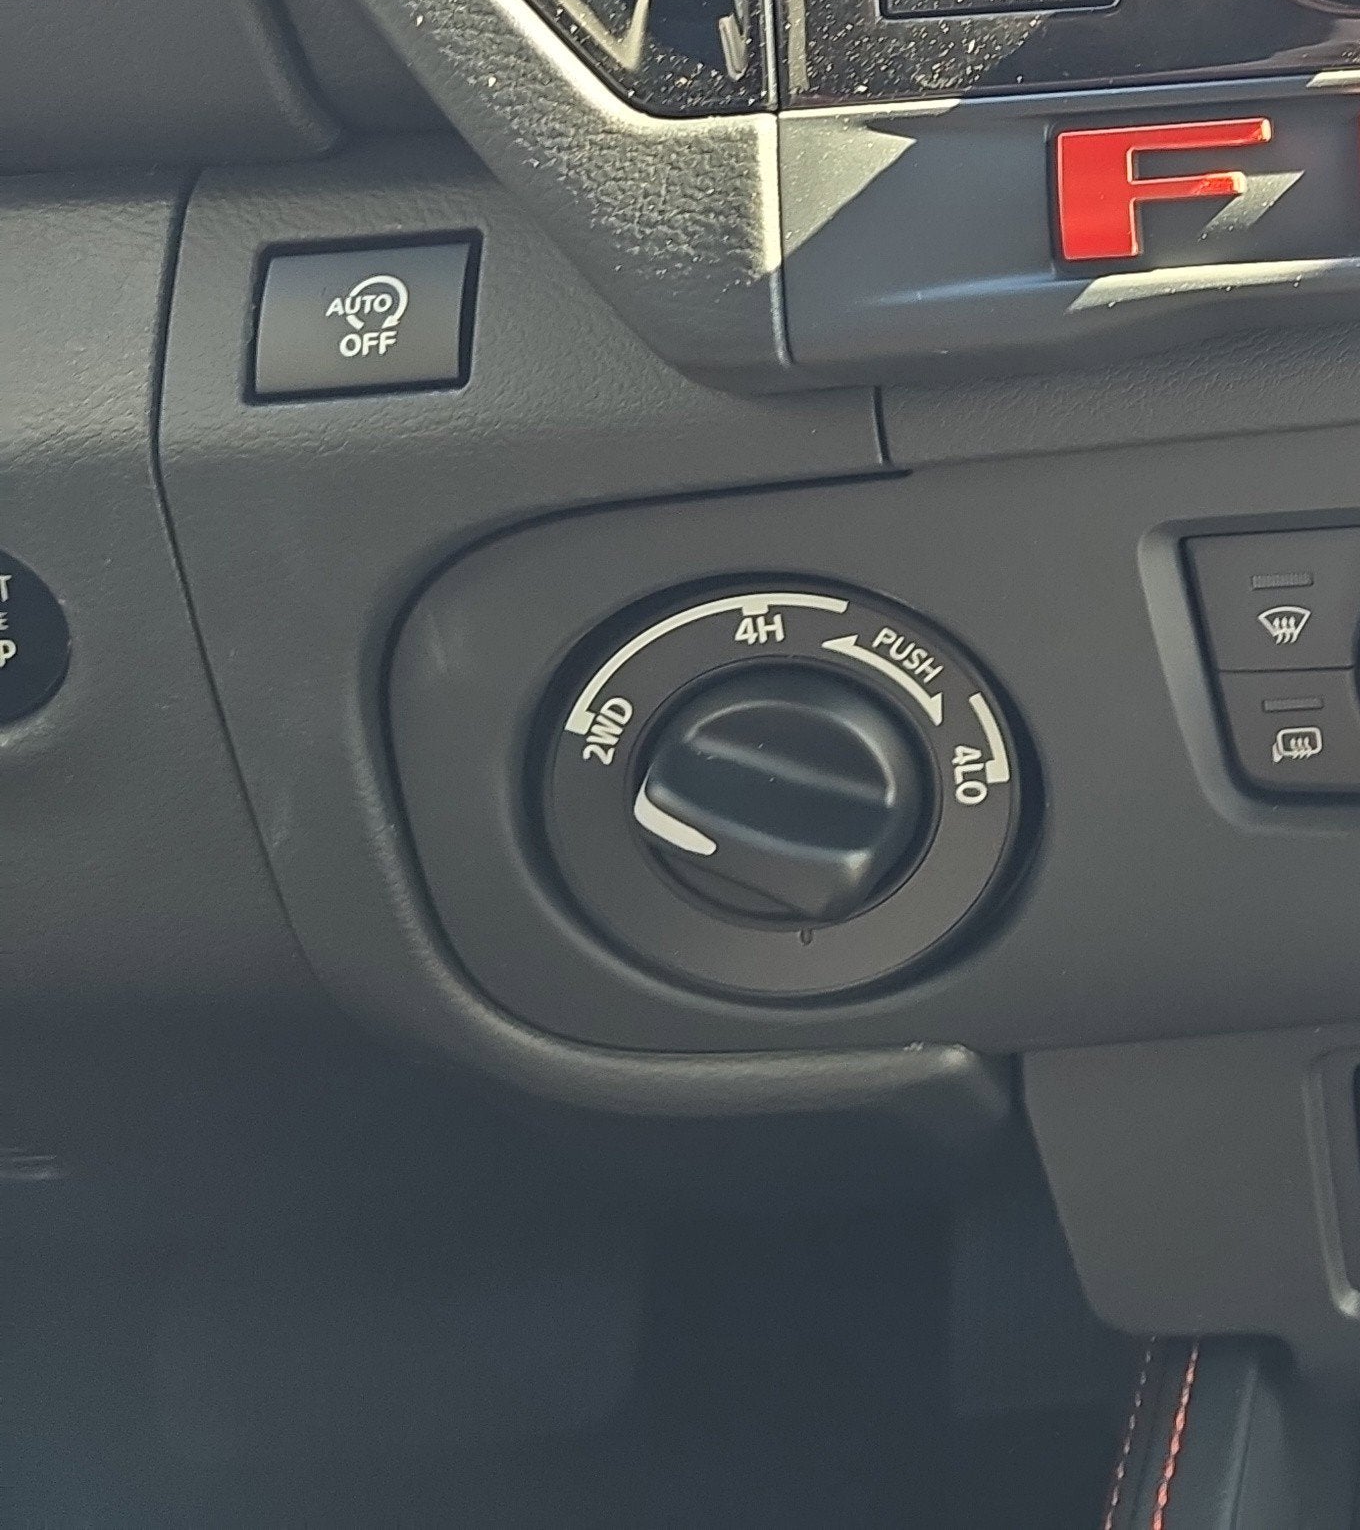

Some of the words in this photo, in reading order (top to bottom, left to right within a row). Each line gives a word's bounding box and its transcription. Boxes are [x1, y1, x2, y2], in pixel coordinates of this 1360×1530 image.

[326, 293, 392, 318] AUTO
[339, 331, 396, 358] OFF
[734, 615, 785, 644] 4H
[873, 627, 943, 684] PUSH
[582, 697, 635, 765] 2WD
[952, 744, 988, 805] 4LO
